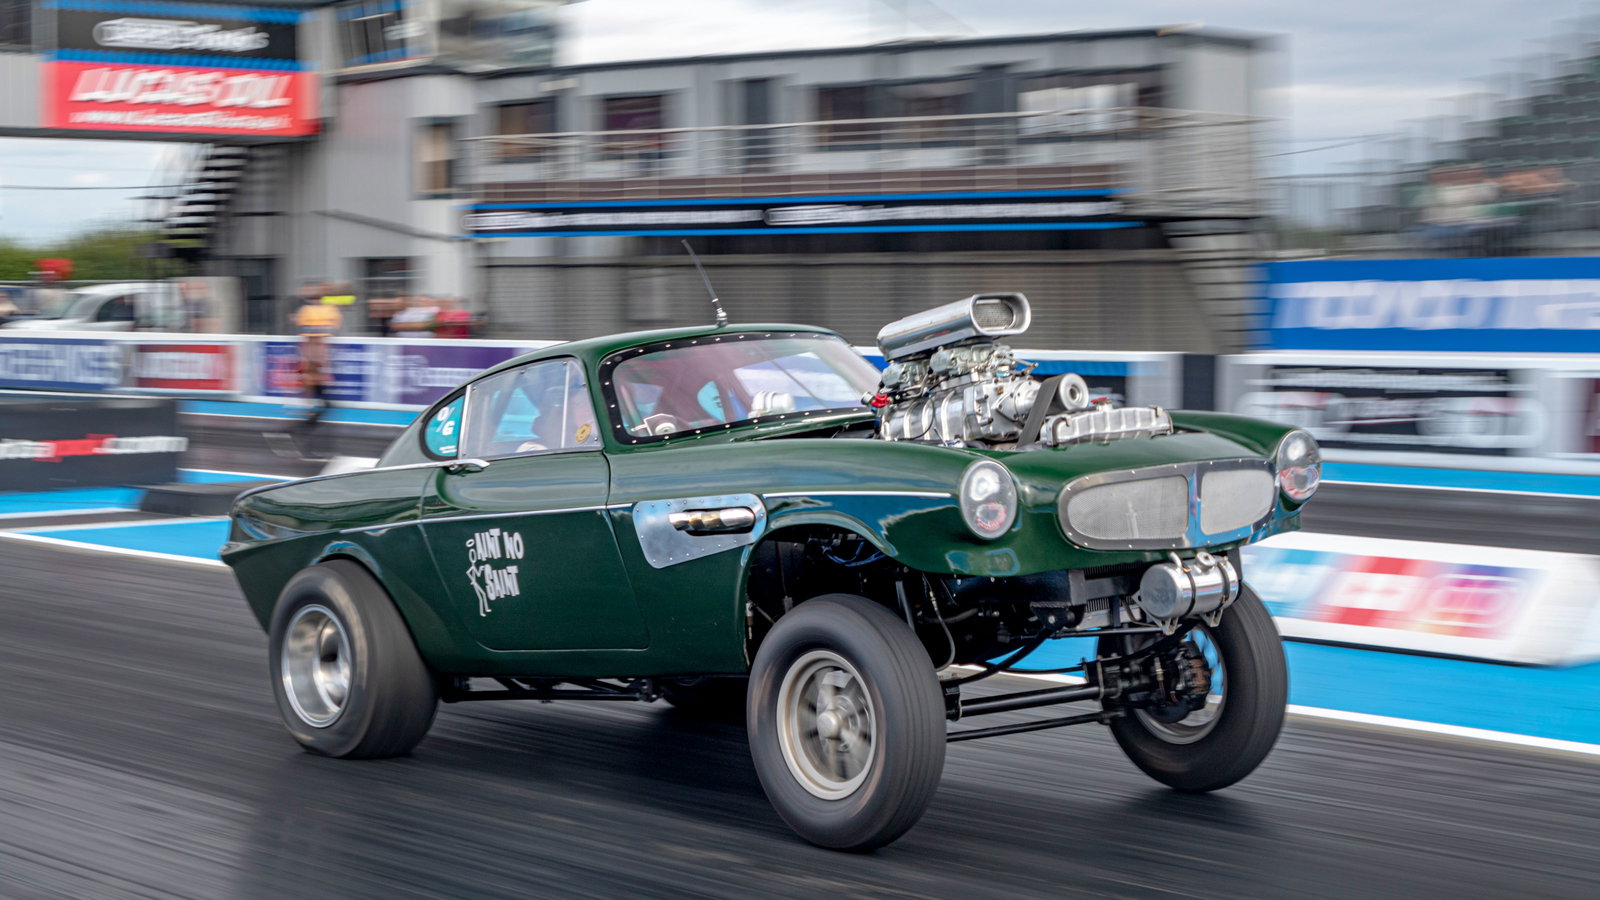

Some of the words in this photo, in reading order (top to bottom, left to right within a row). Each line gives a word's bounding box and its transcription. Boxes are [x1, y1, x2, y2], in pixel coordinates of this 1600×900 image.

[474, 528, 501, 561] AINT
[503, 531, 524, 559] NO
[484, 564, 520, 600] SAINT
